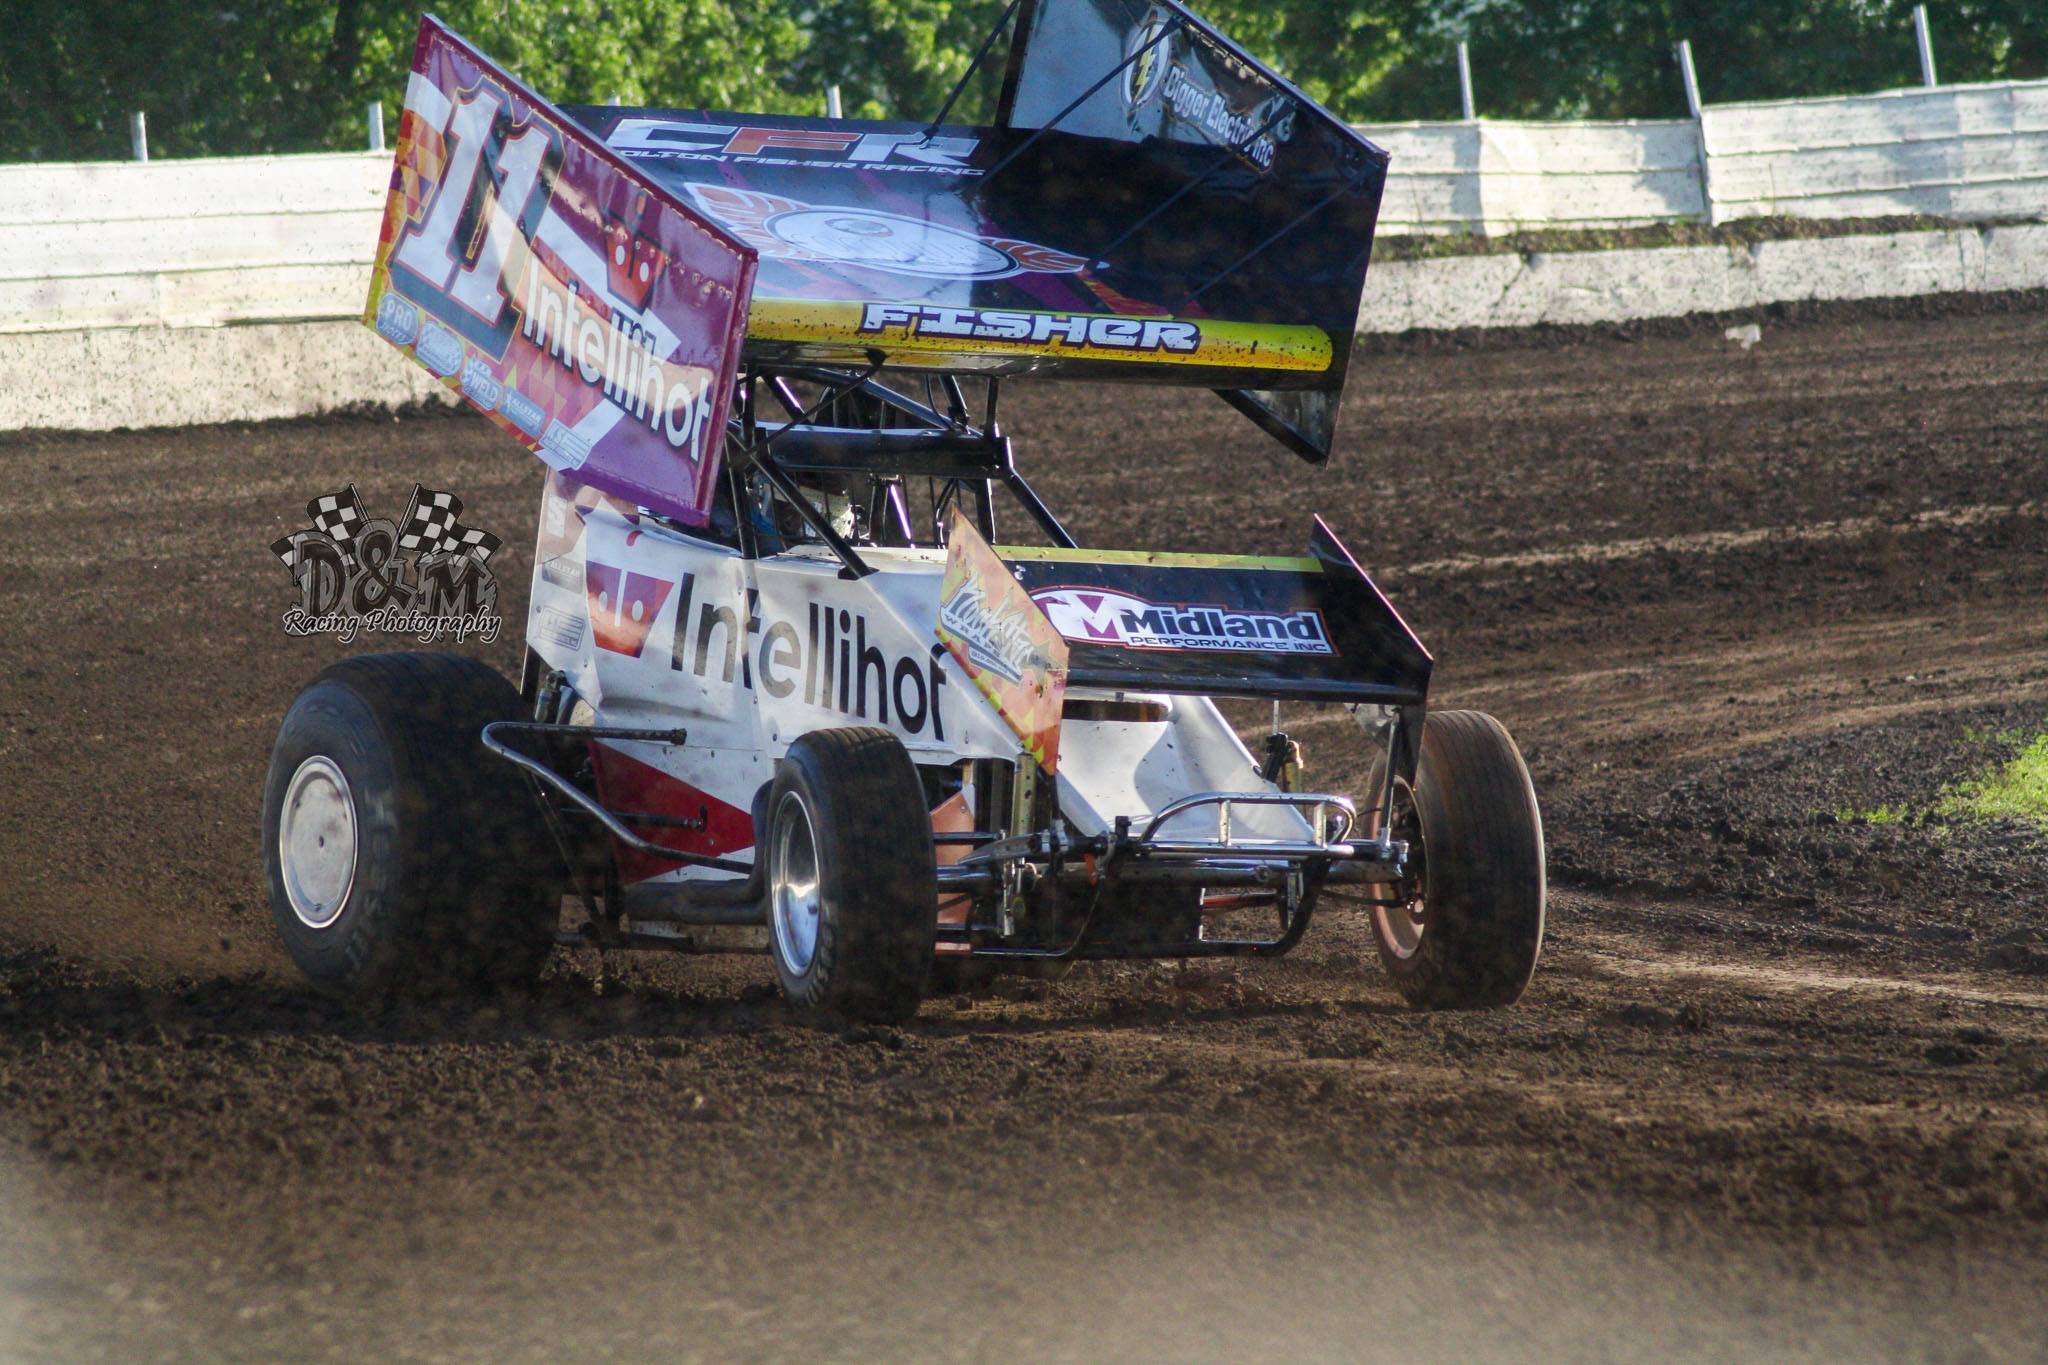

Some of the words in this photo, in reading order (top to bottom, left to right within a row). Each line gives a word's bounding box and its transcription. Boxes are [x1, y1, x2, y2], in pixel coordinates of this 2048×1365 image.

[1163, 66, 1209, 118] Bigger
[605, 118, 981, 167] CFR
[617, 150, 728, 162] OLTON
[733, 156, 858, 169] FISHER
[862, 163, 986, 176] RACING
[396, 89, 551, 328] 11
[863, 302, 1201, 353] FISHER
[1119, 608, 1321, 641] Midland
[1129, 636, 1289, 650] PERFORMANCE
[1294, 642, 1327, 652] INC
